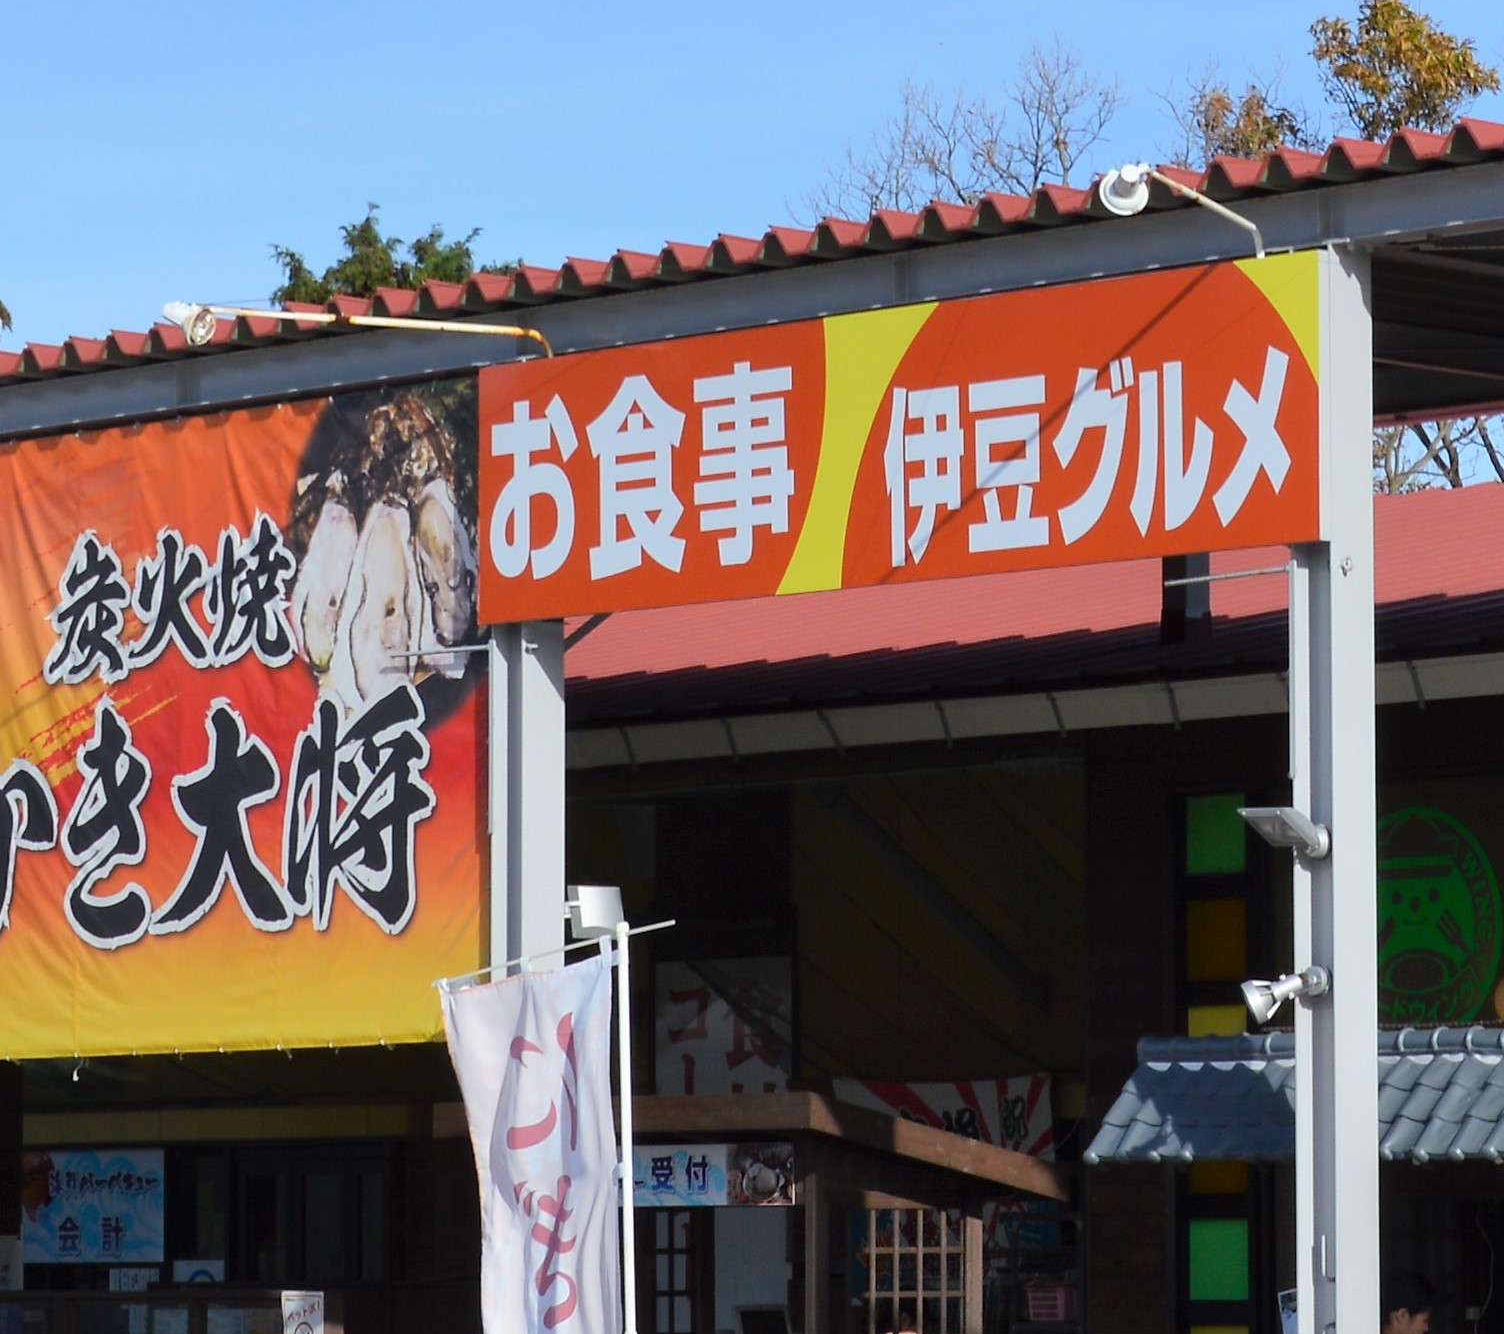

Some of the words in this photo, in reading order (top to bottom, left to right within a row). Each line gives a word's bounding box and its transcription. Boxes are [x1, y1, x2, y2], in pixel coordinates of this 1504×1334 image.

[490, 362, 795, 581] お食事
[884, 345, 1291, 566] 伊豆グルメ
[48, 513, 295, 681] 炭火焼
[652, 1155, 708, 1193] 受付
[58, 1216, 124, 1253] 会計
